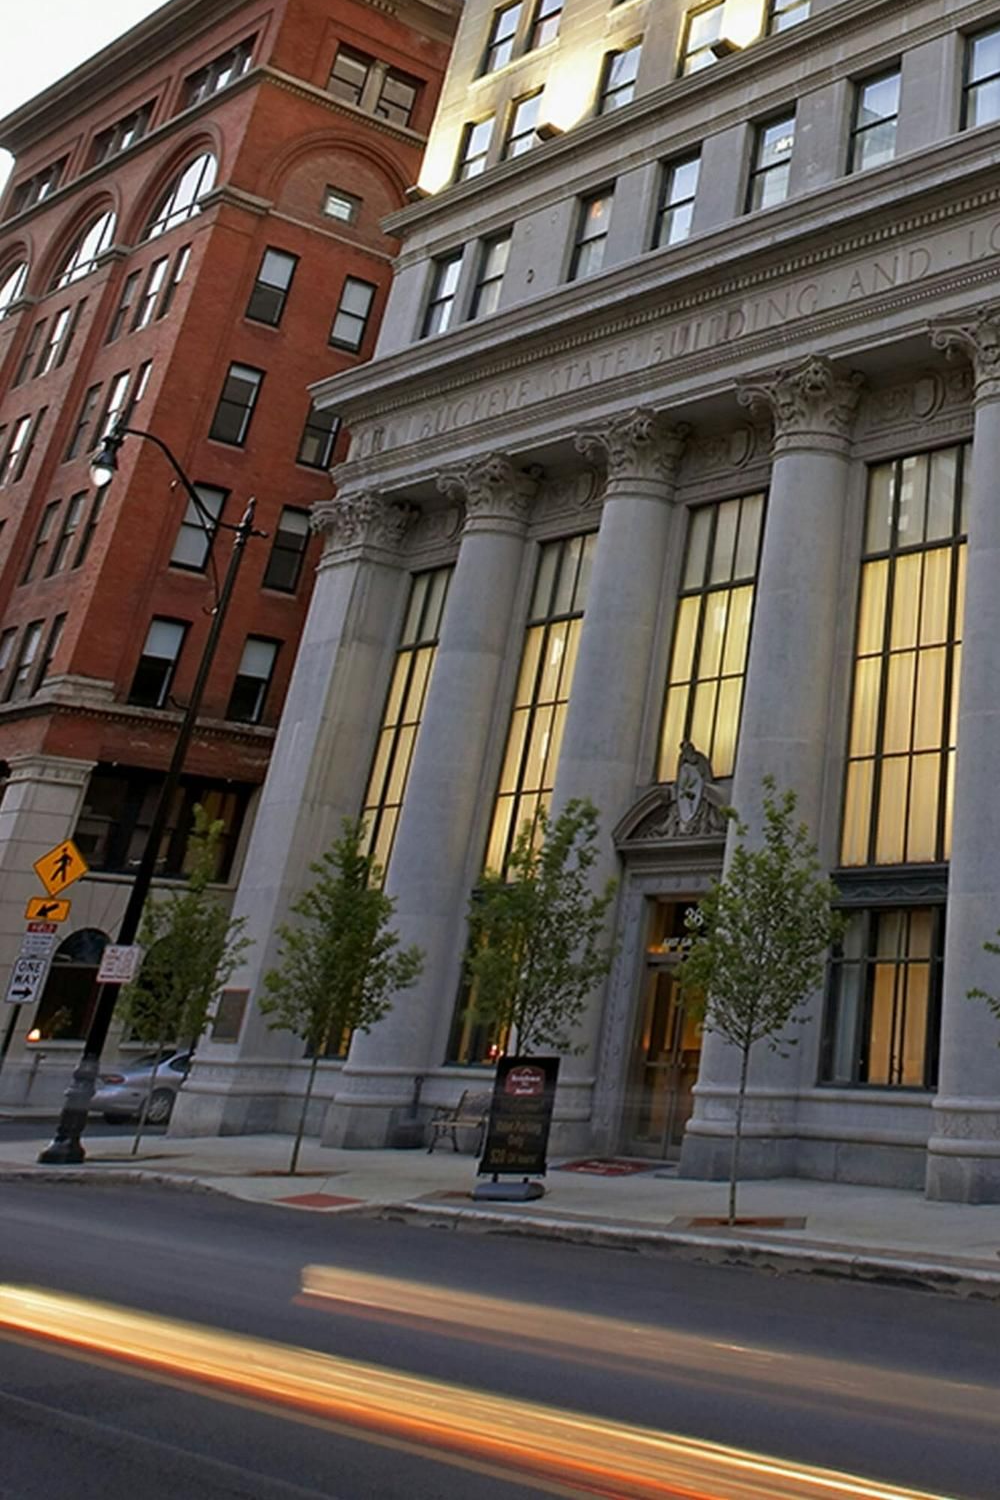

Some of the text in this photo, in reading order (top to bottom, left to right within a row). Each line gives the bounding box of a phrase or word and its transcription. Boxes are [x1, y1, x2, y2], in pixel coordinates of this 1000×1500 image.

[420, 378, 534, 435] BUCKEYE
[544, 346, 632, 396] STATE
[655, 282, 820, 359] BUILDING
[847, 246, 933, 298] AND
[18, 961, 42, 973] ONE
[14, 974, 40, 985] WAY
